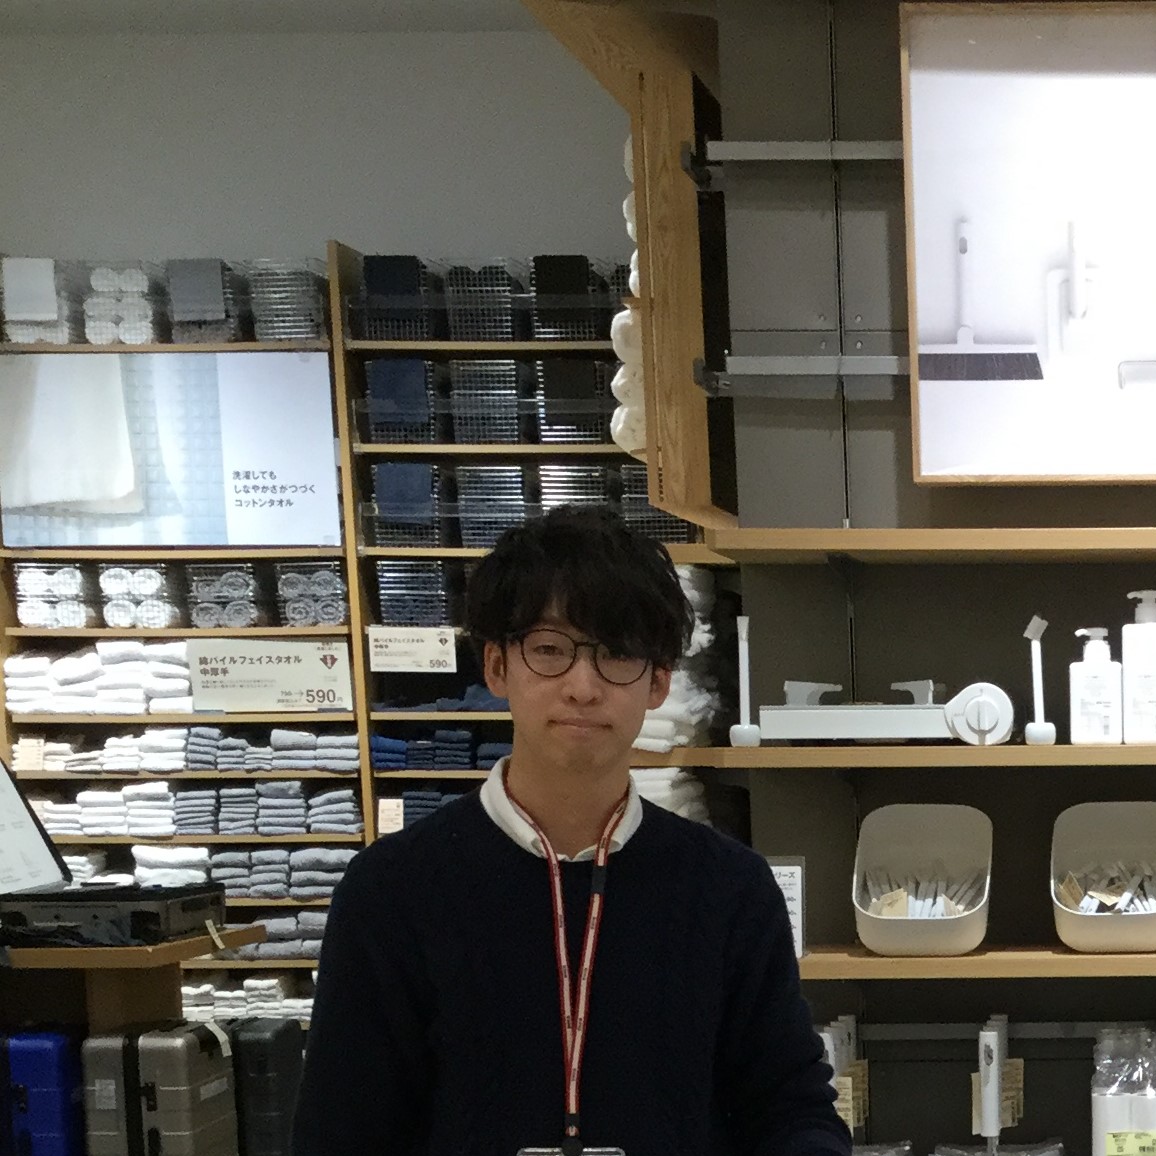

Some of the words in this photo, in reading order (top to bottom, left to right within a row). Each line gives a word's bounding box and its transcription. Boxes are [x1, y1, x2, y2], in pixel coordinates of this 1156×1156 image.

[234, 484, 316, 494] しなやかさがつづく
[235, 499, 294, 507] コットンタオル
